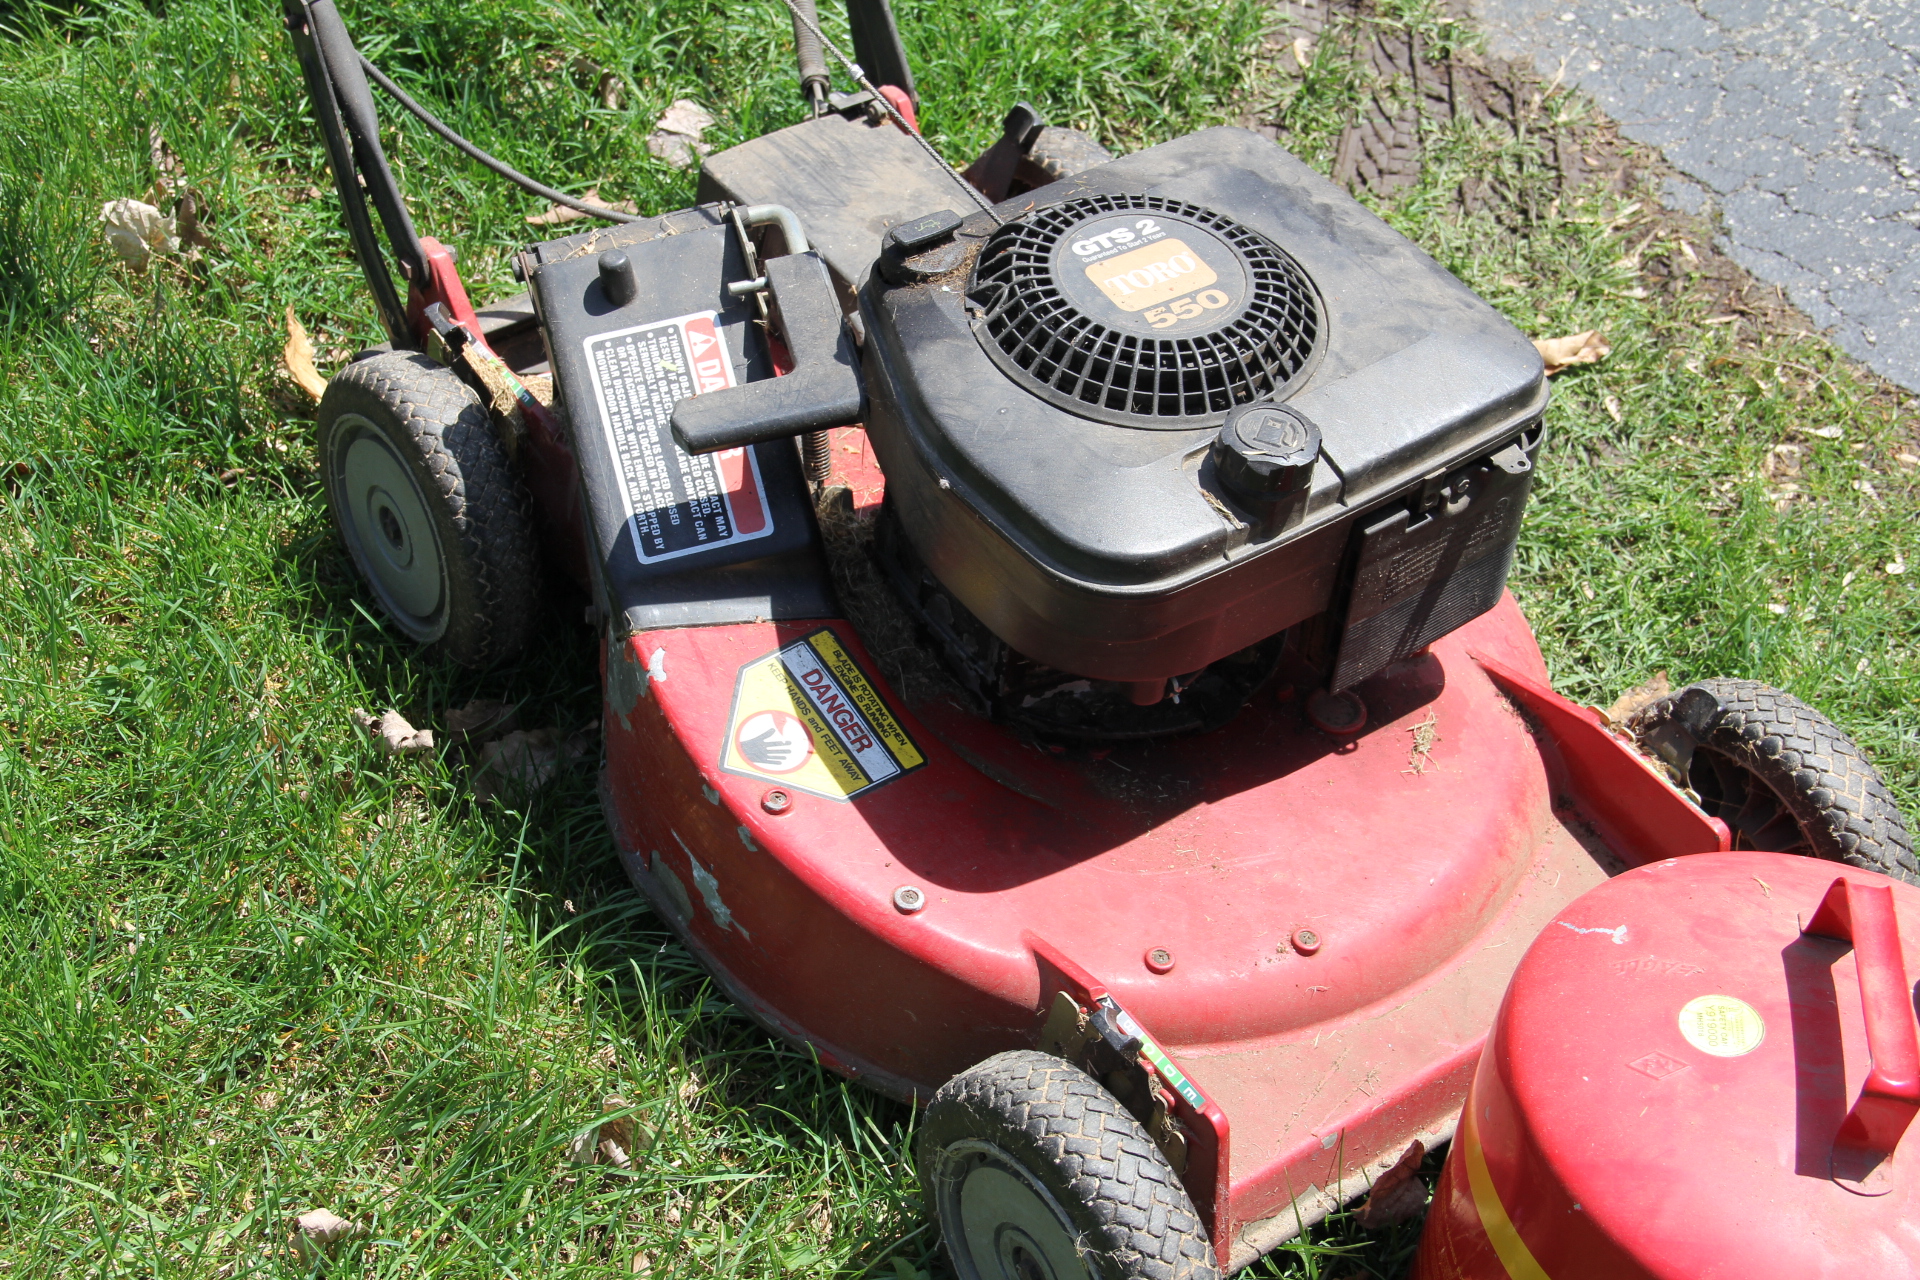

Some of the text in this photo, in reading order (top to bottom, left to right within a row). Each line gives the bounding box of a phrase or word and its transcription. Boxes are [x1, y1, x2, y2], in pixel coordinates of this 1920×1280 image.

[1072, 219, 1161, 256] GTS 2
[1082, 248, 1118, 263] Guaranteed
[1116, 244, 1127, 252] To
[1126, 238, 1143, 249] Start
[1148, 231, 1166, 241] Years
[1104, 254, 1196, 295] TORO
[1144, 289, 1229, 328] 550
[615, 345, 666, 513] OR ATTACHMENT IS LOCKED IN PLACE.
[625, 343, 680, 525] OPERATE ONLY IF DOOR IS LOCKED CLOSED
[637, 340, 667, 428] SERIOUSLY INJURE.
[667, 333, 686, 373] THROWN
[678, 374, 692, 398] OBJE
[702, 470, 722, 514] CONTACT
[714, 515, 728, 537] MAY
[594, 349, 650, 536] MOVING DOOR HANDLE BACK AND FORTH.
[604, 347, 664, 550] CLEAR DISCHARGE WITH ENGINE STOPPED BY
[646, 337, 665, 378] THROWN
[681, 474, 701, 518] CONTACT
[693, 520, 707, 541] CAN
[667, 371, 677, 381] IF
[694, 478, 712, 517] CLOSED.
[768, 663, 862, 781] KEEP HANDS and FEET AWAY
[801, 669, 873, 753] DANGER
[833, 649, 907, 746] BLADE IS ROTATING WHEN
[835, 664, 892, 738] ENGINE IS RUNNING
[1102, 997, 1197, 1101] A B C D E
